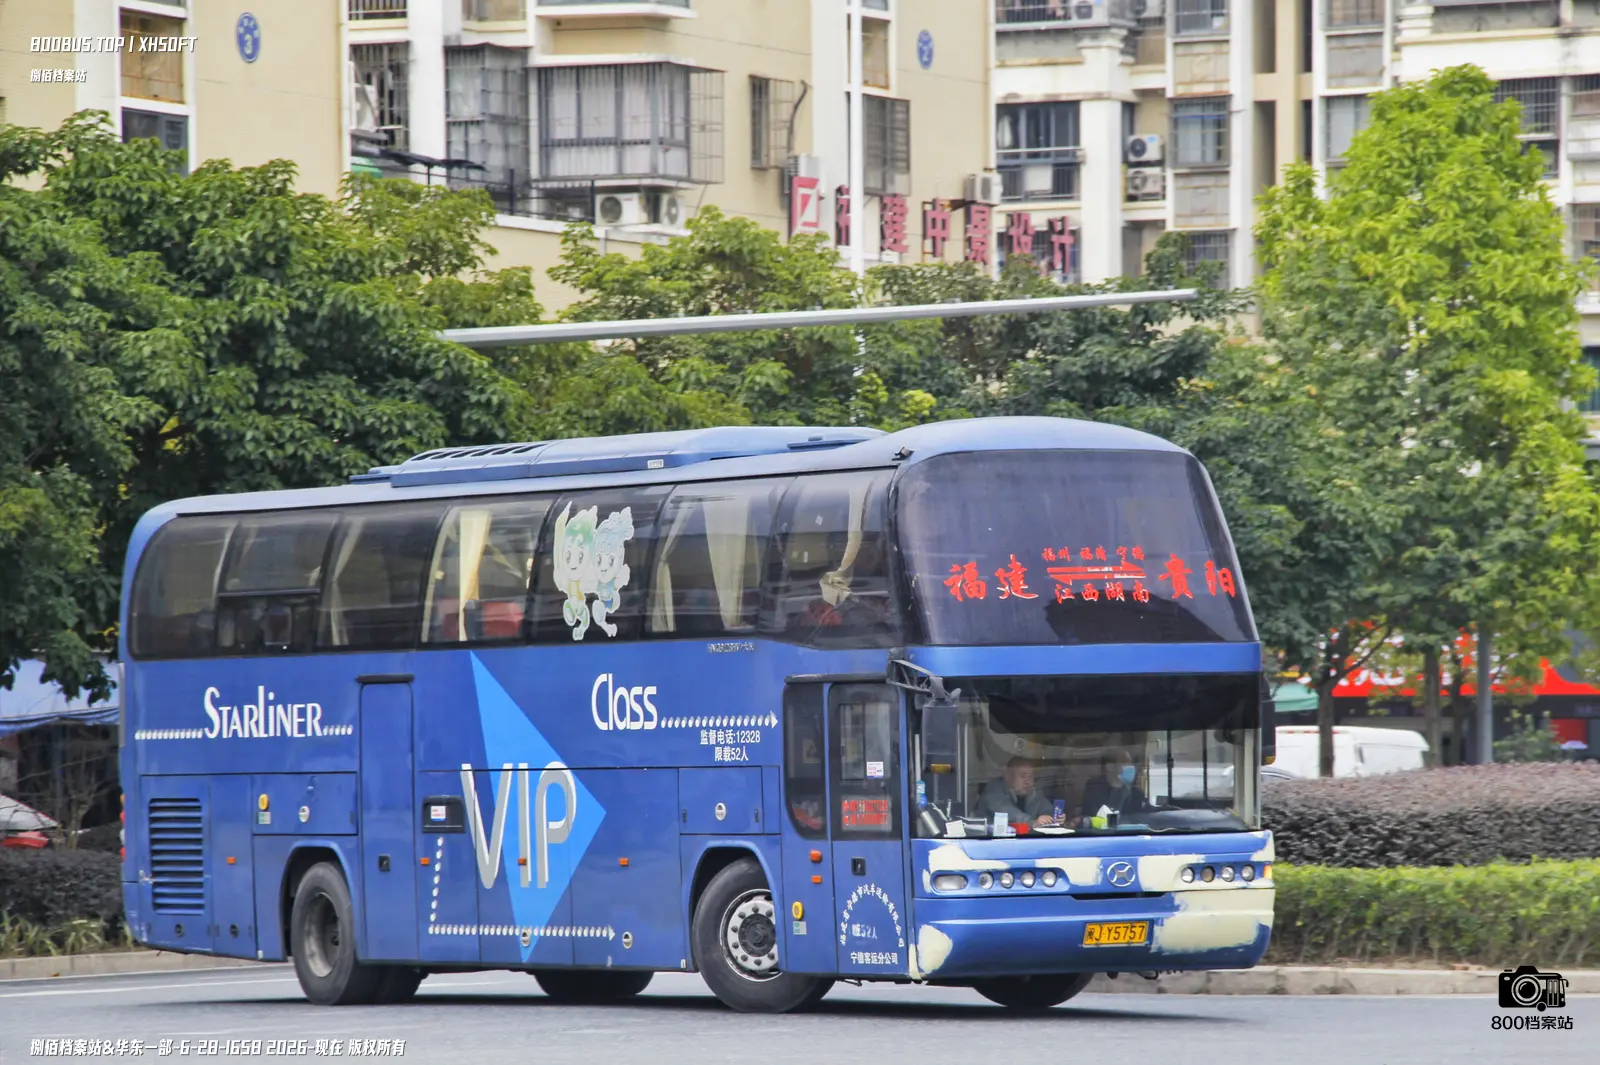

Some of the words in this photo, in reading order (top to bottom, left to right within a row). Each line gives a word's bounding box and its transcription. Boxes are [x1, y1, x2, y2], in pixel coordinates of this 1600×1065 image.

[943, 553, 1039, 602] 福建
[591, 673, 658, 730] Class
[714, 746, 749, 762] 限载52人
[460, 761, 577, 889] VIP
[850, 951, 899, 965] 宁德客运分公司
